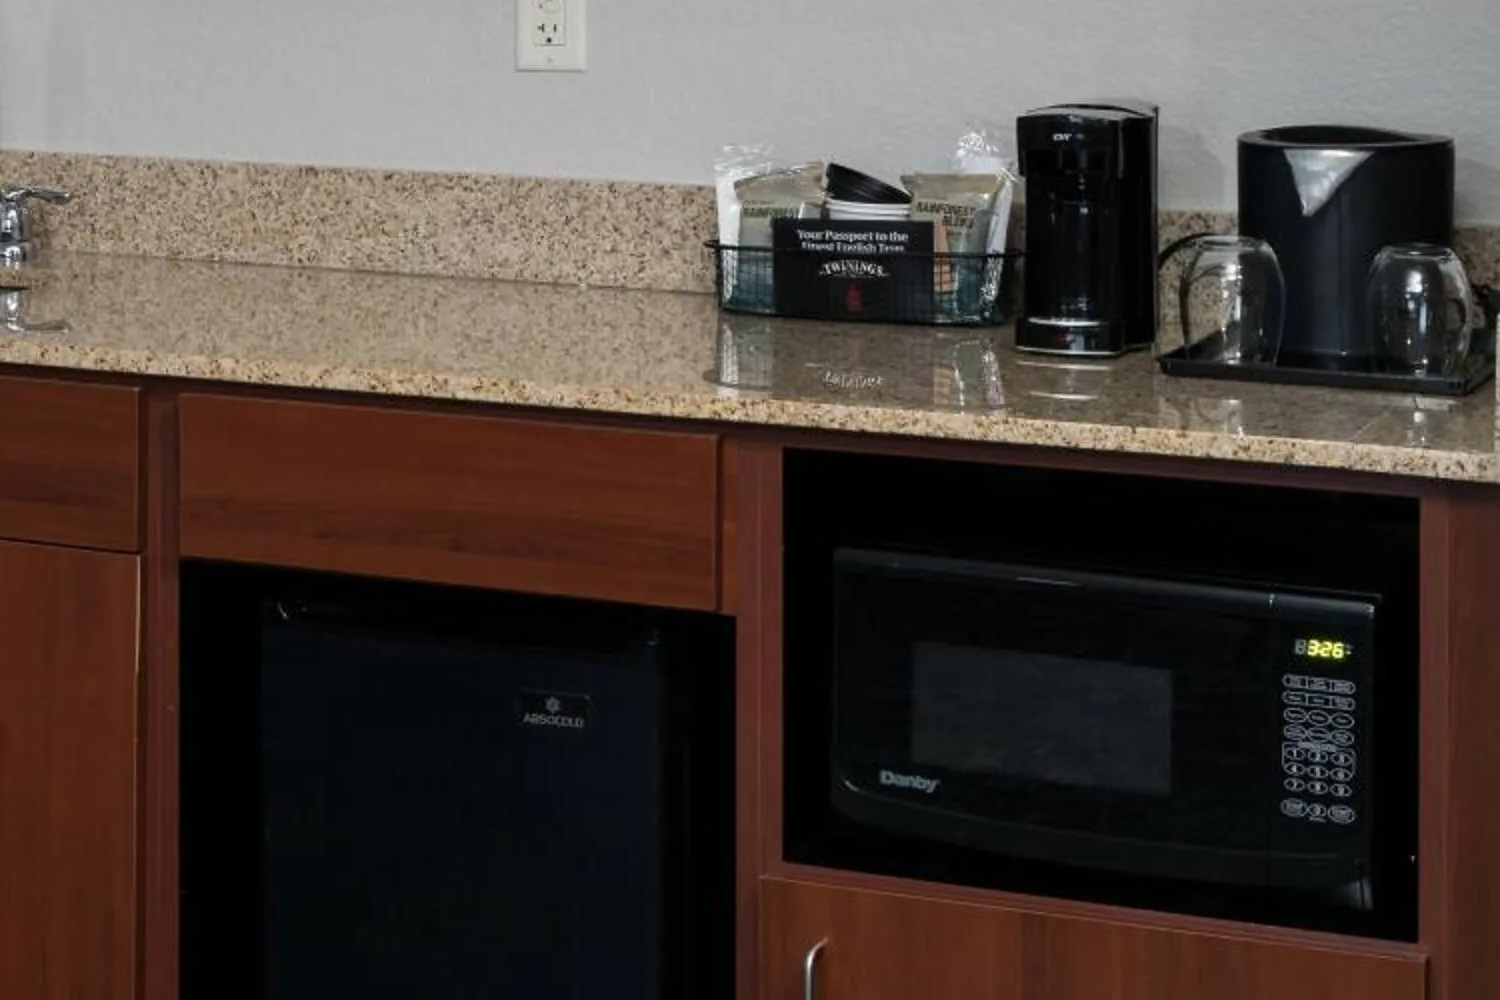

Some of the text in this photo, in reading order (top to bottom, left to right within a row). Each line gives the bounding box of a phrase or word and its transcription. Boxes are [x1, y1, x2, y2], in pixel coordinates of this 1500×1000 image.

[797, 229, 909, 243] Your Passport to the
[822, 259, 884, 275] TWININGS
[879, 769, 941, 794] Danby
